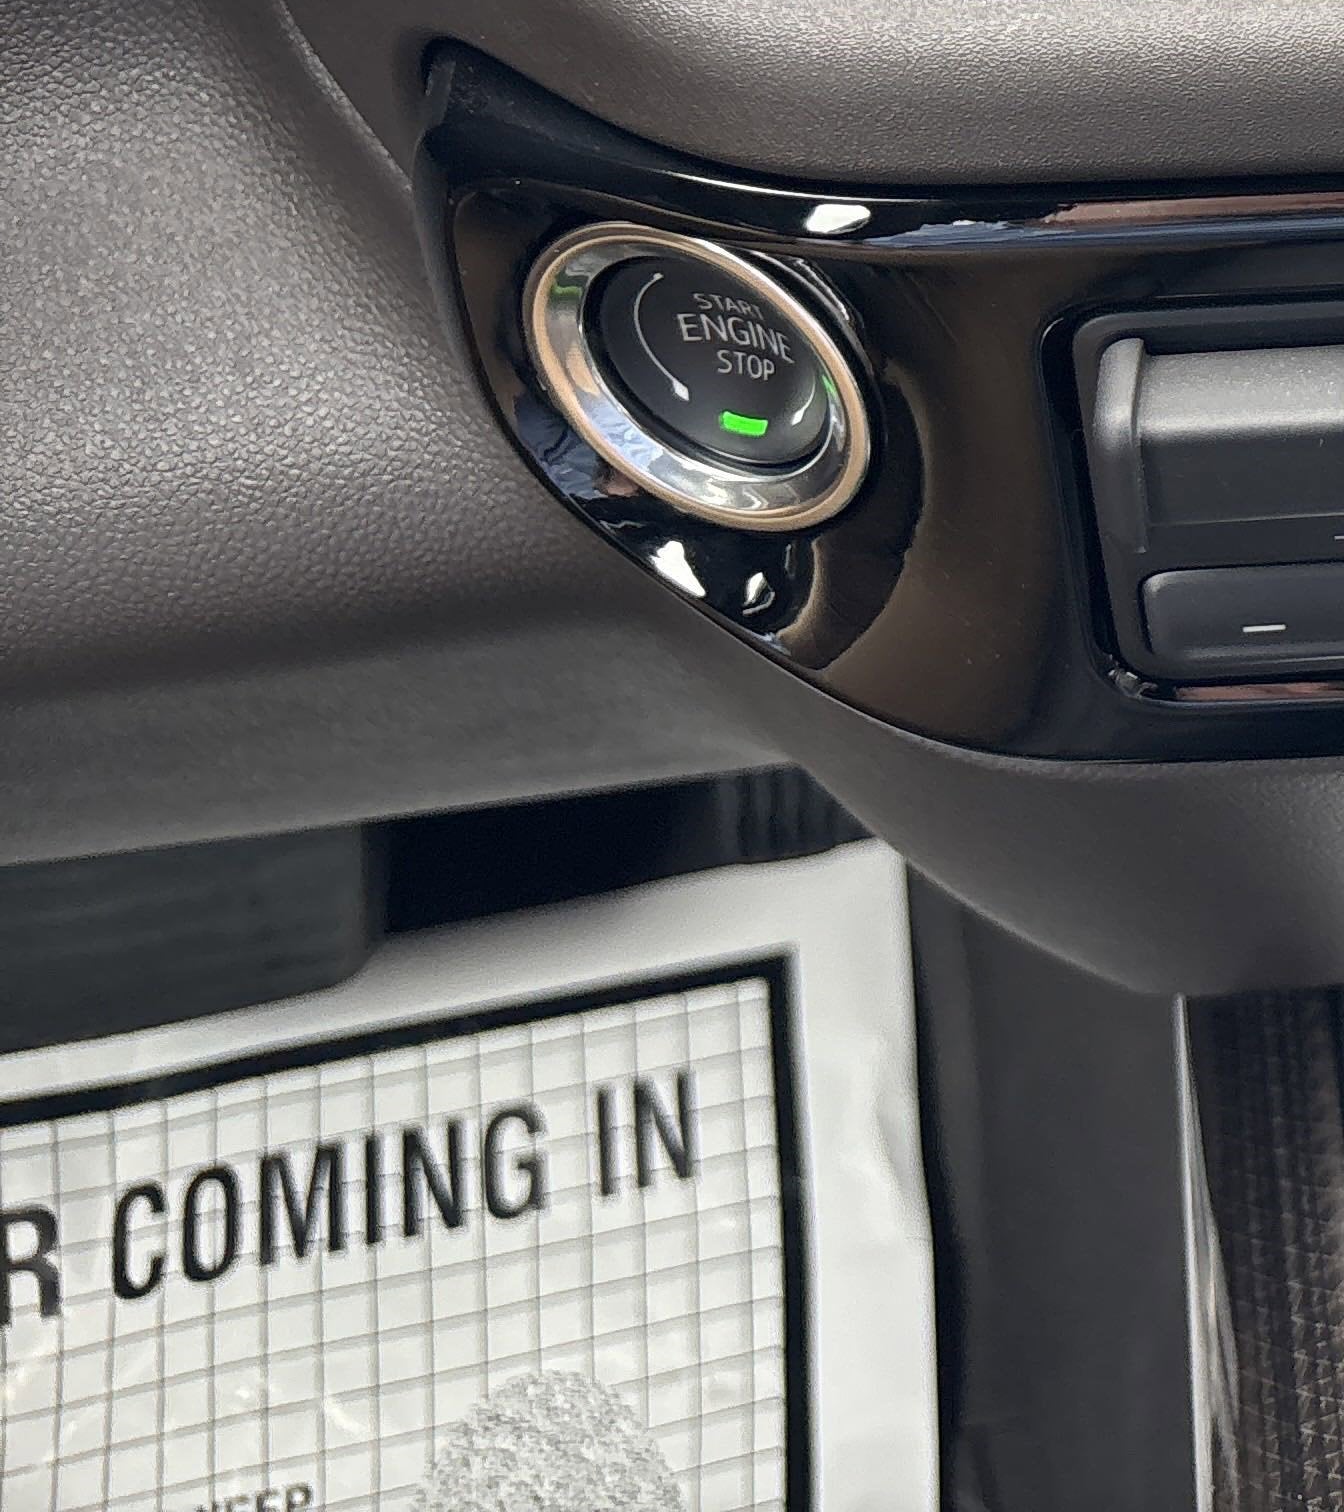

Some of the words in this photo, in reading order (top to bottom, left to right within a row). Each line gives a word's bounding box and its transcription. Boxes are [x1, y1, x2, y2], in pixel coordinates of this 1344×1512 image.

[693, 292, 765, 320] START
[676, 313, 796, 364] ENGINE
[716, 349, 776, 381] STOP
[110, 1100, 547, 1301] COMING
[595, 1070, 697, 1198] IN
